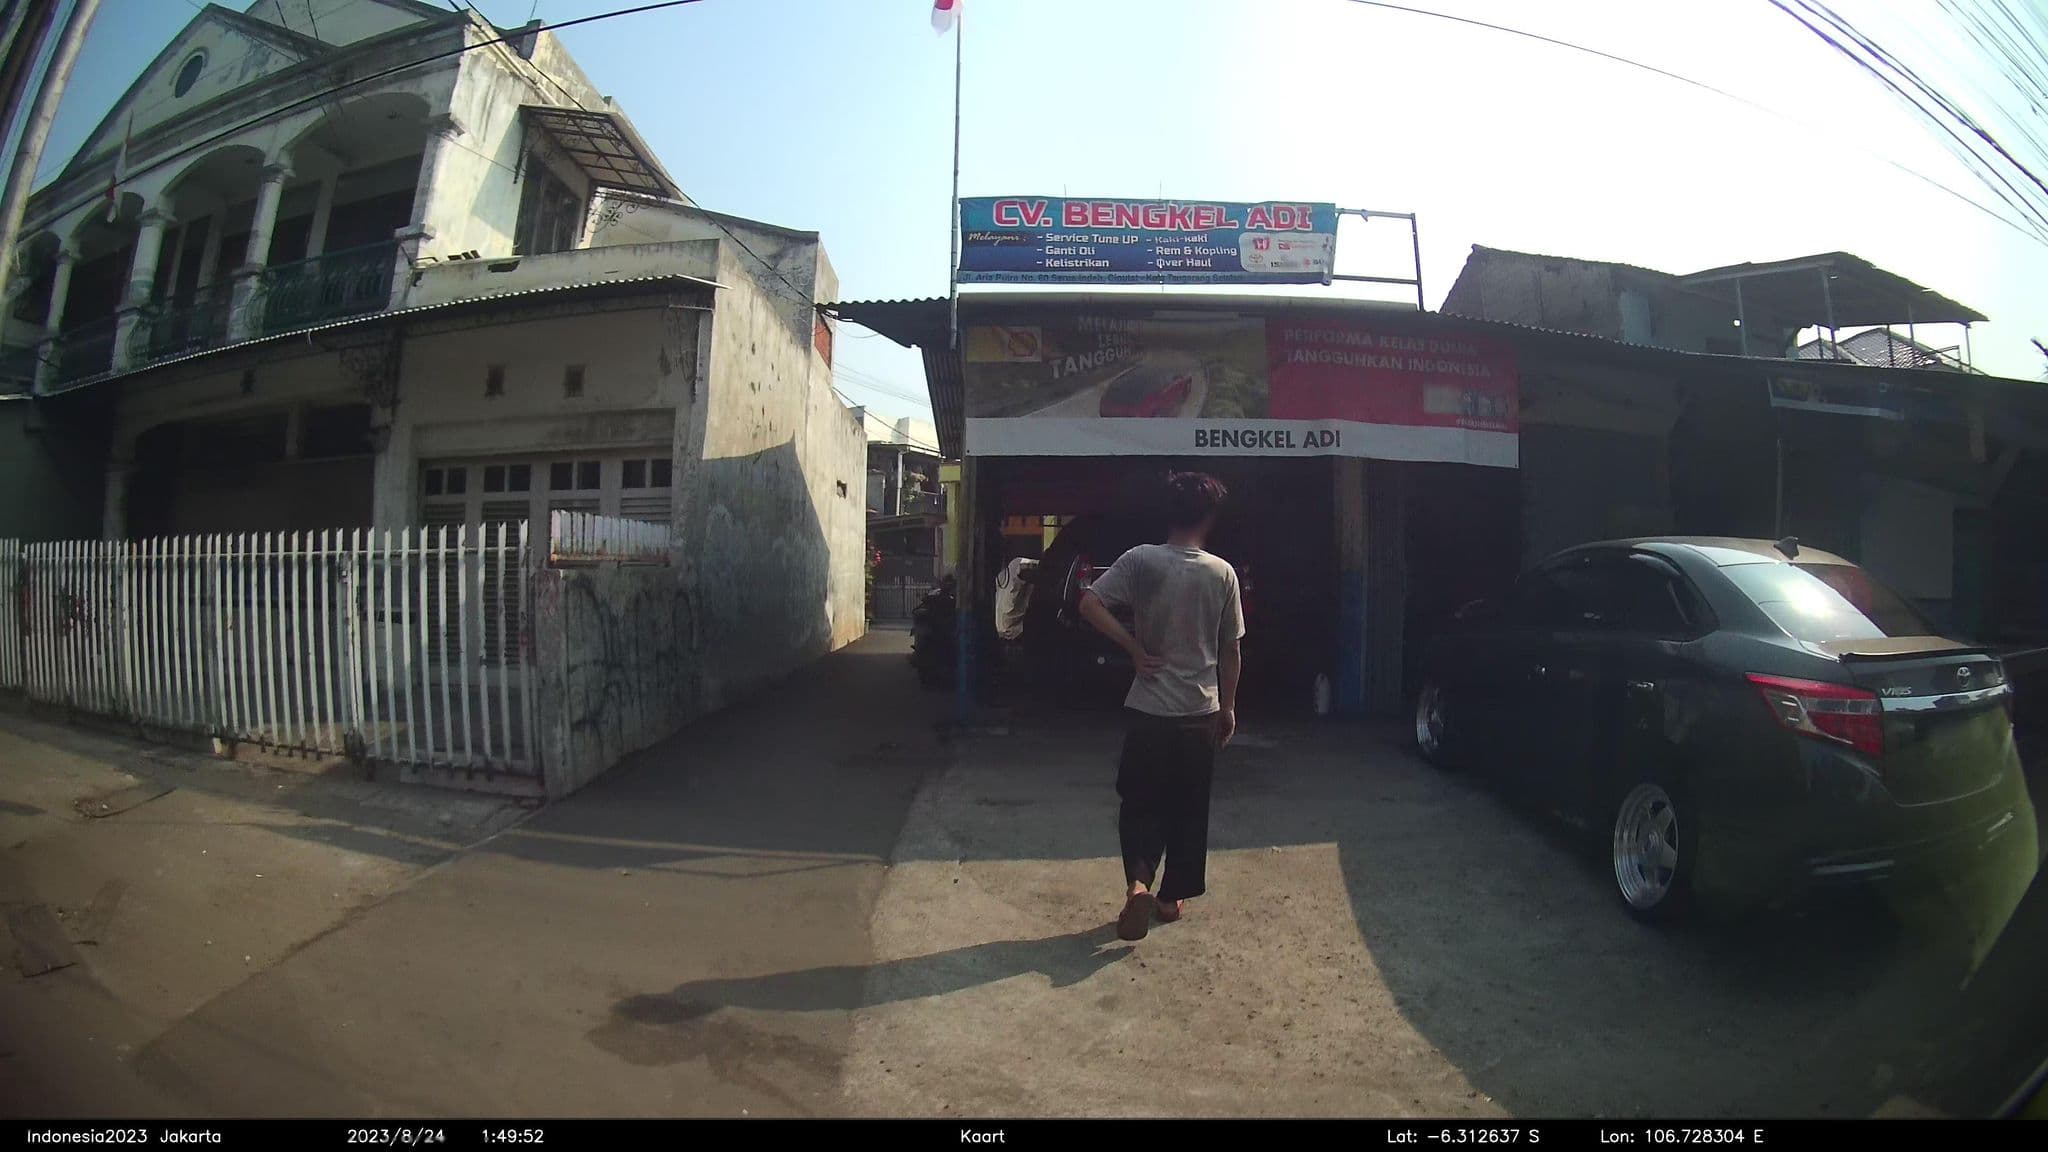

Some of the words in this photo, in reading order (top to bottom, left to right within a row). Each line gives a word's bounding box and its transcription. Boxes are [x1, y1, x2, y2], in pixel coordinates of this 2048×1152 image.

[994, 200, 1052, 227] CV.
[1063, 201, 1238, 231] BENGKEL
[1245, 204, 1312, 230] ADI
[1045, 233, 1089, 243] Service
[1092, 234, 1120, 244] Tune
[1122, 235, 1139, 244] UP
[1045, 246, 1076, 255] Ganti
[1079, 246, 1095, 255] Oli
[1156, 246, 1181, 255] Rem
[1183, 246, 1192, 255] &
[1195, 246, 1237, 256] Kopling
[1045, 258, 1109, 267] Kelistrikan
[1156, 258, 1183, 267] Over
[1186, 258, 1212, 267] Haul
[1194, 429, 1296, 448] BENGKEL
[1303, 429, 1341, 448] ADI
